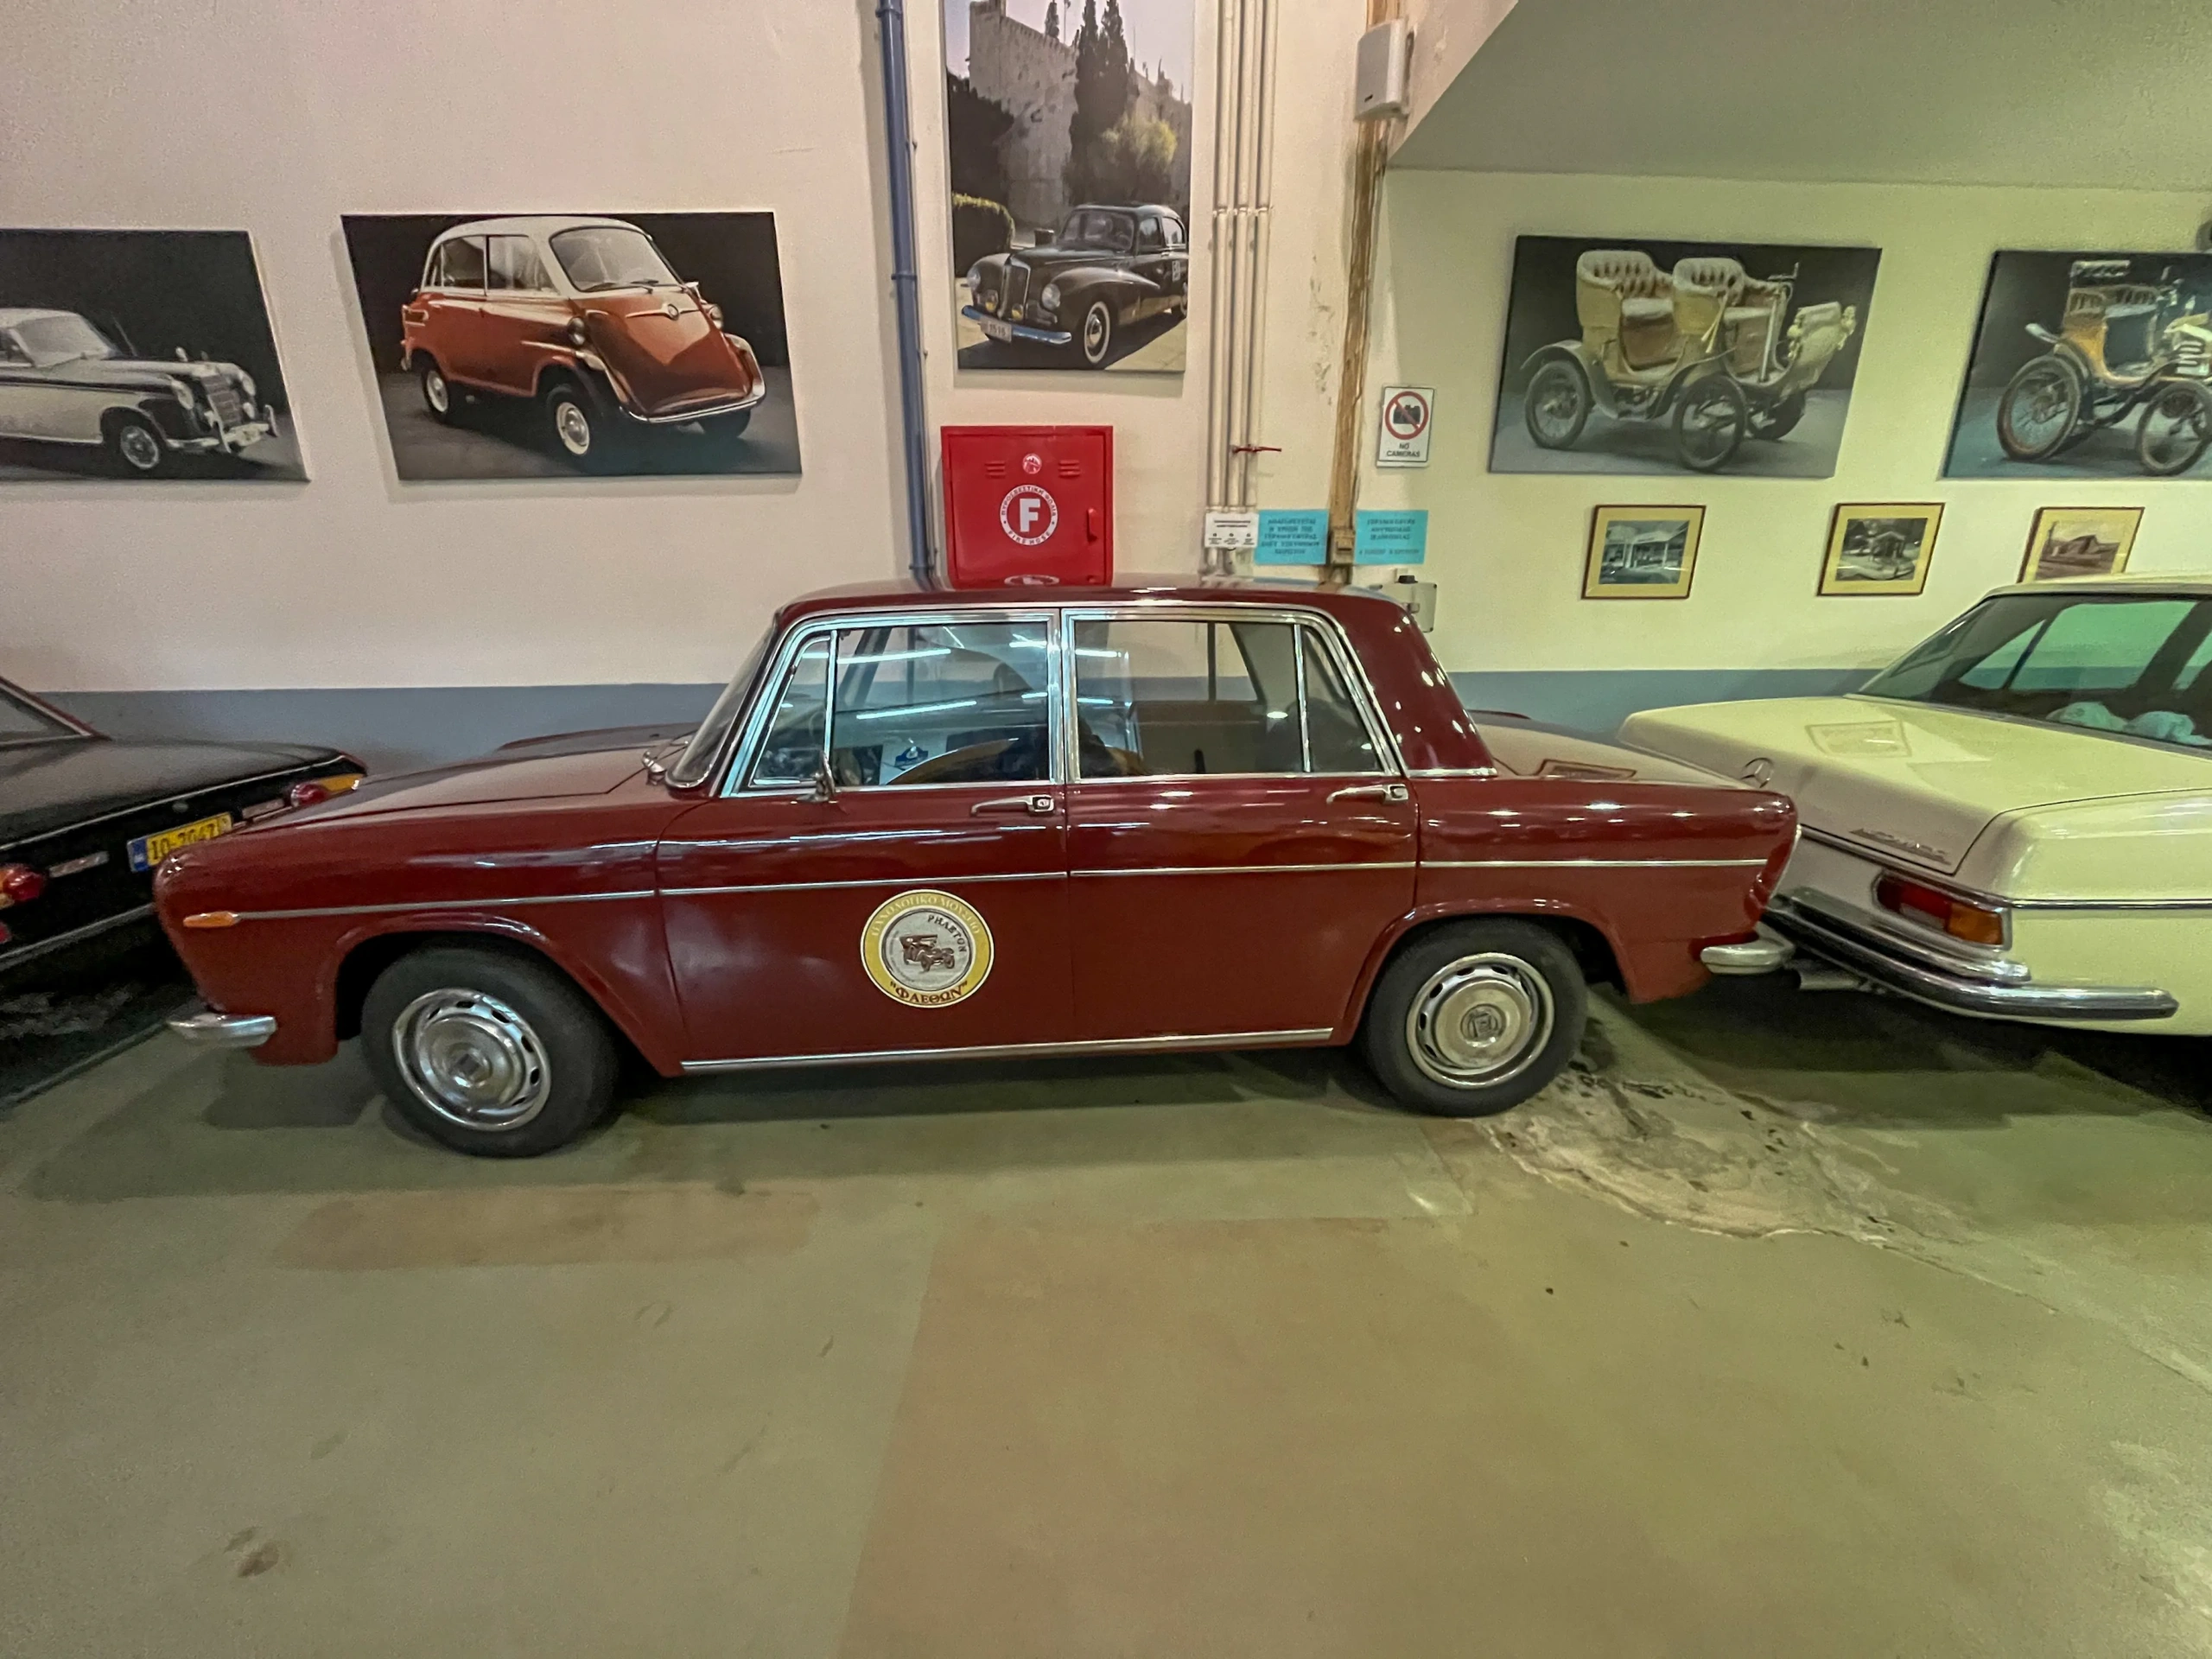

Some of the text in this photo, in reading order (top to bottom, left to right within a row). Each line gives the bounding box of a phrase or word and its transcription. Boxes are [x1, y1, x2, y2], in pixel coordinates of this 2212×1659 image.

[1020, 498, 1041, 532] F
[1007, 530, 1051, 544] FIRE HOSE
